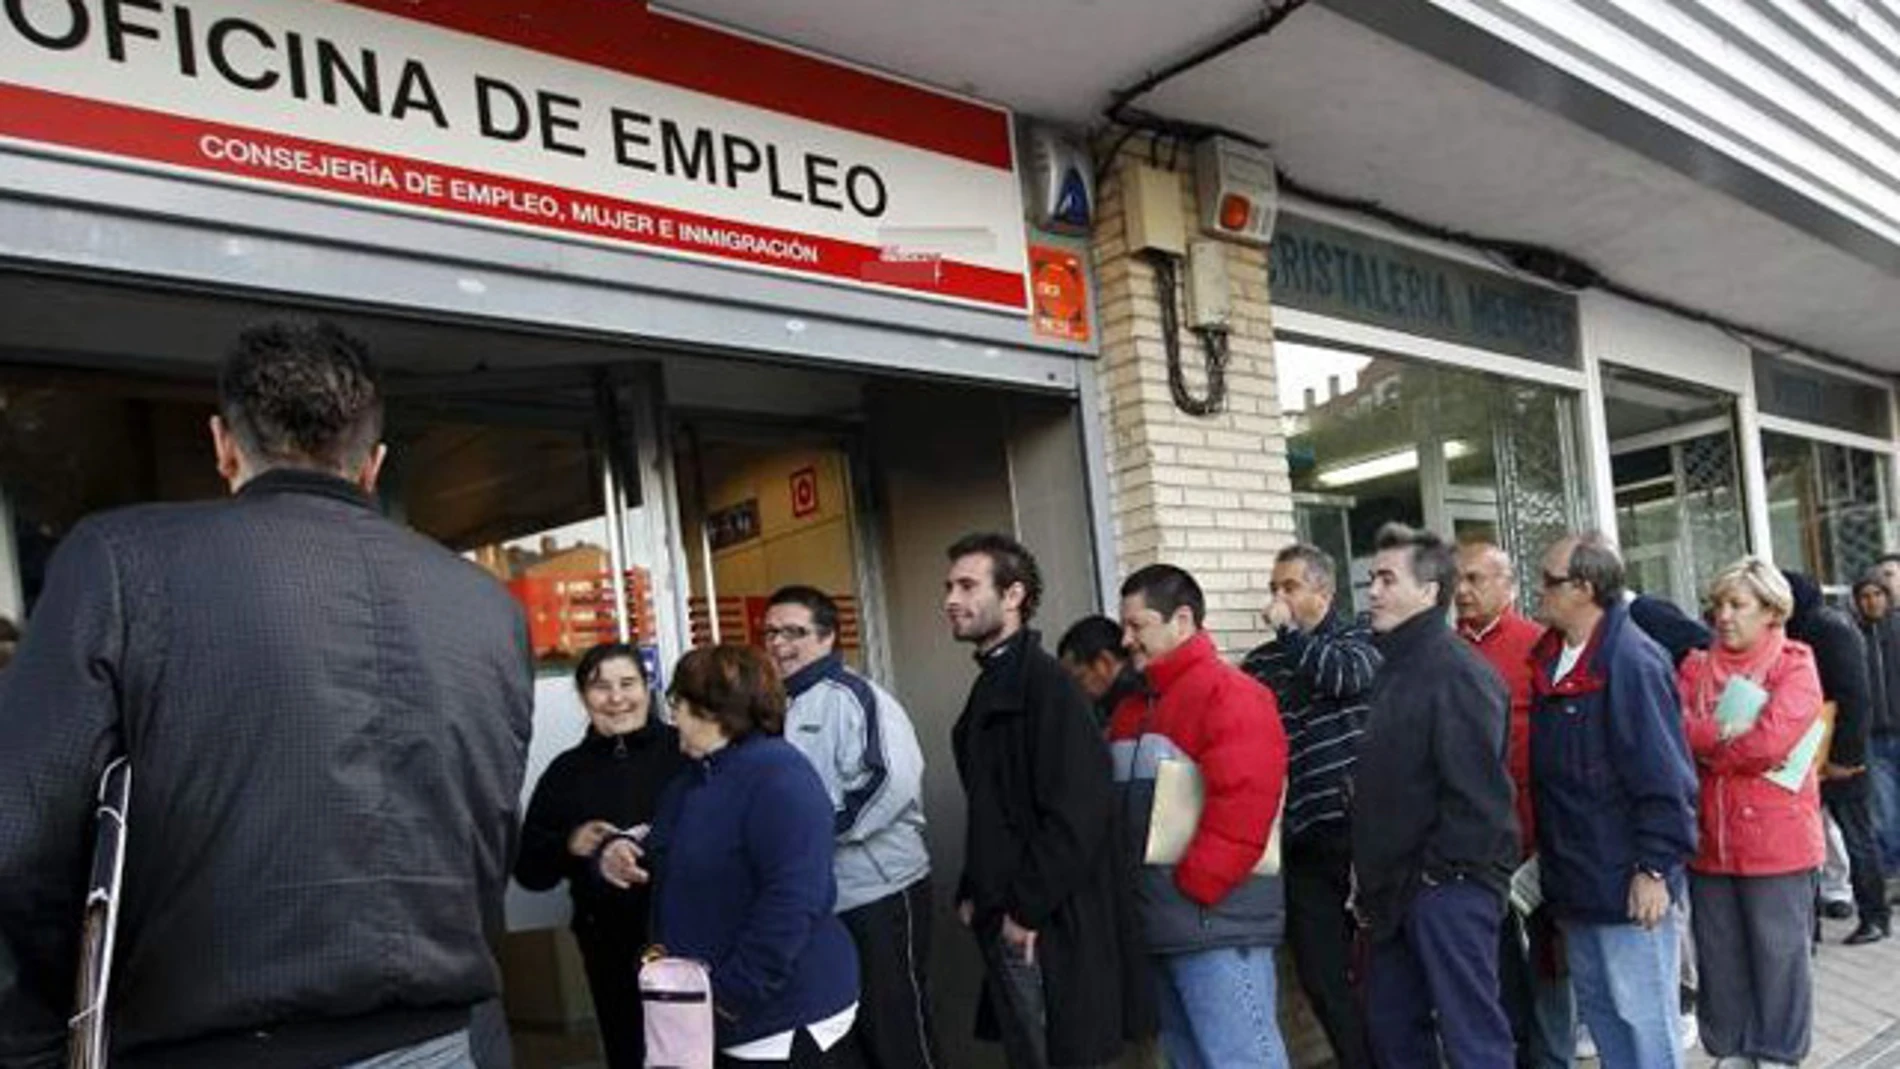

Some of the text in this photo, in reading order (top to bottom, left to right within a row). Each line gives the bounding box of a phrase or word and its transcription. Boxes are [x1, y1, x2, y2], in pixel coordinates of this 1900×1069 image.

[4, 0, 888, 219] OFICINA DE EMPLEO
[200, 134, 819, 263] CONSEJERÍA DE EMPLEO, MUJER E INMIGRACIÓN
